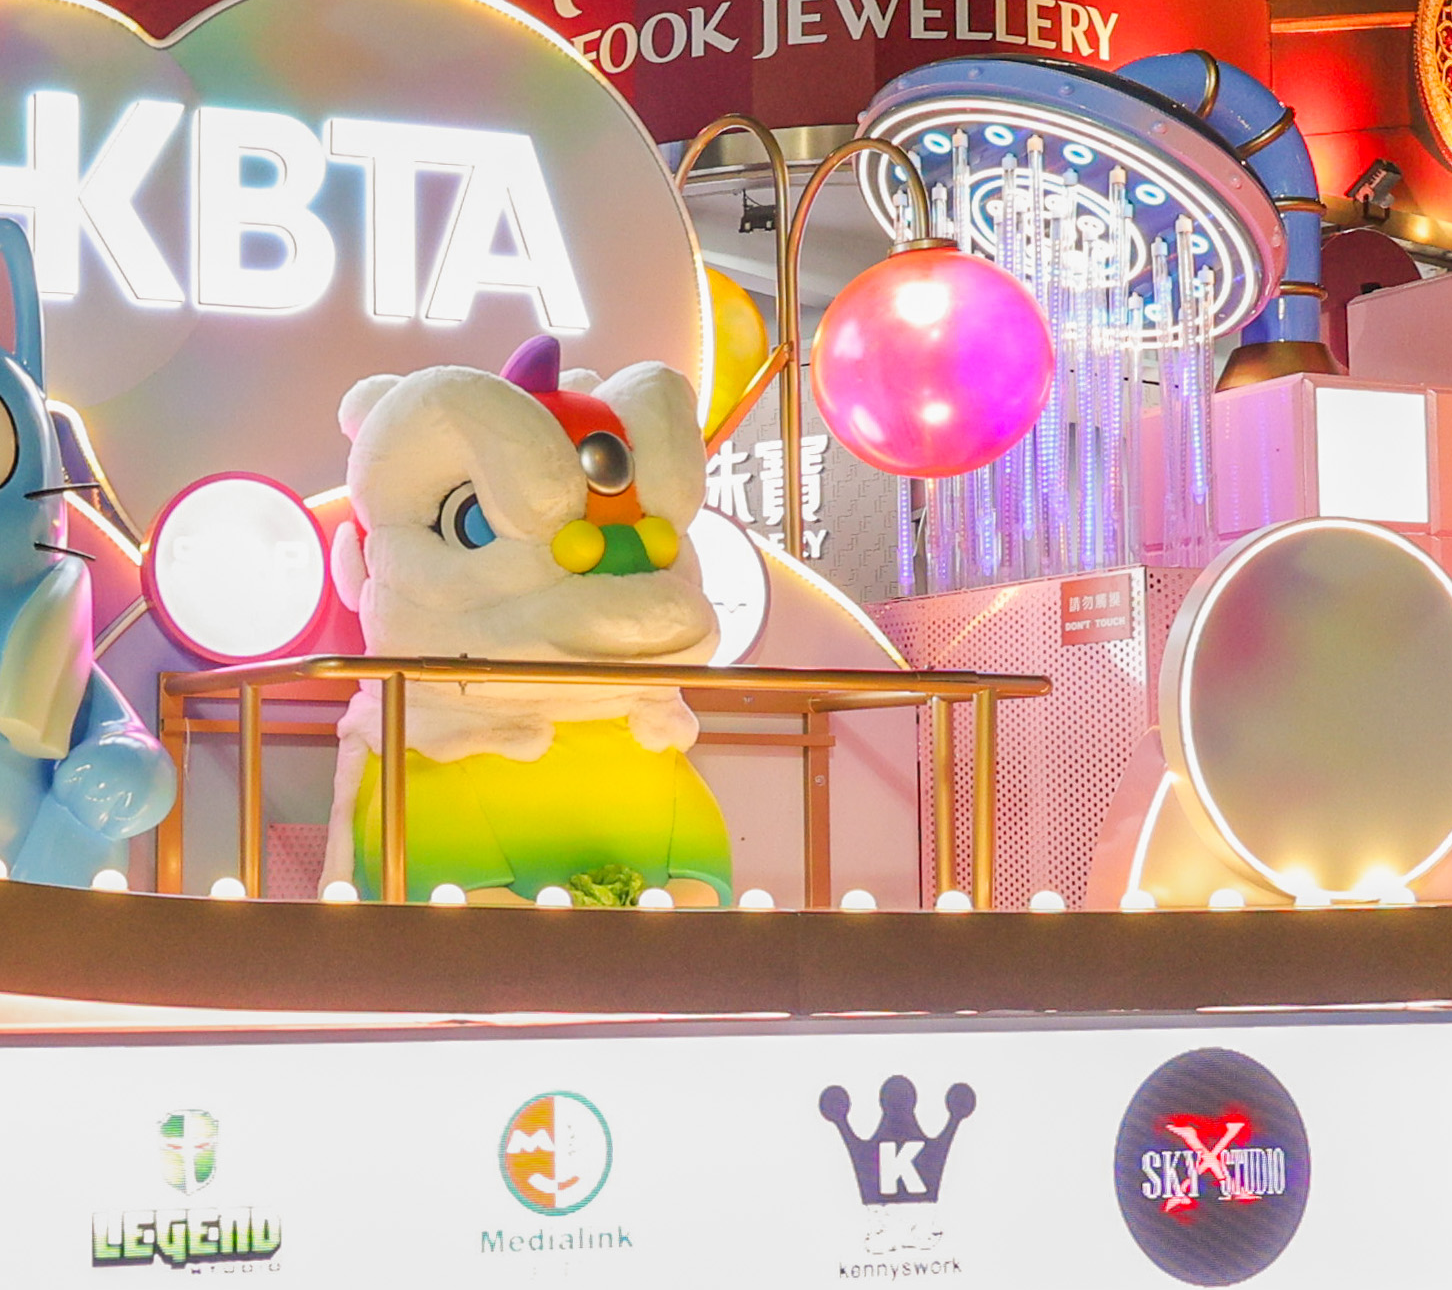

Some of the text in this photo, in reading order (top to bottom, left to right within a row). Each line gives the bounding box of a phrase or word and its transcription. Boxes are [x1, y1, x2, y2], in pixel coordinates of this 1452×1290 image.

[571, 1, 740, 75] FOOK
[1095, 615, 1127, 629] TOUCH
[878, 1140, 928, 1195] K
[91, 1207, 283, 1270] LEGEND
[480, 1225, 634, 1254] Medialink
[838, 1257, 963, 1282] kennyswork
